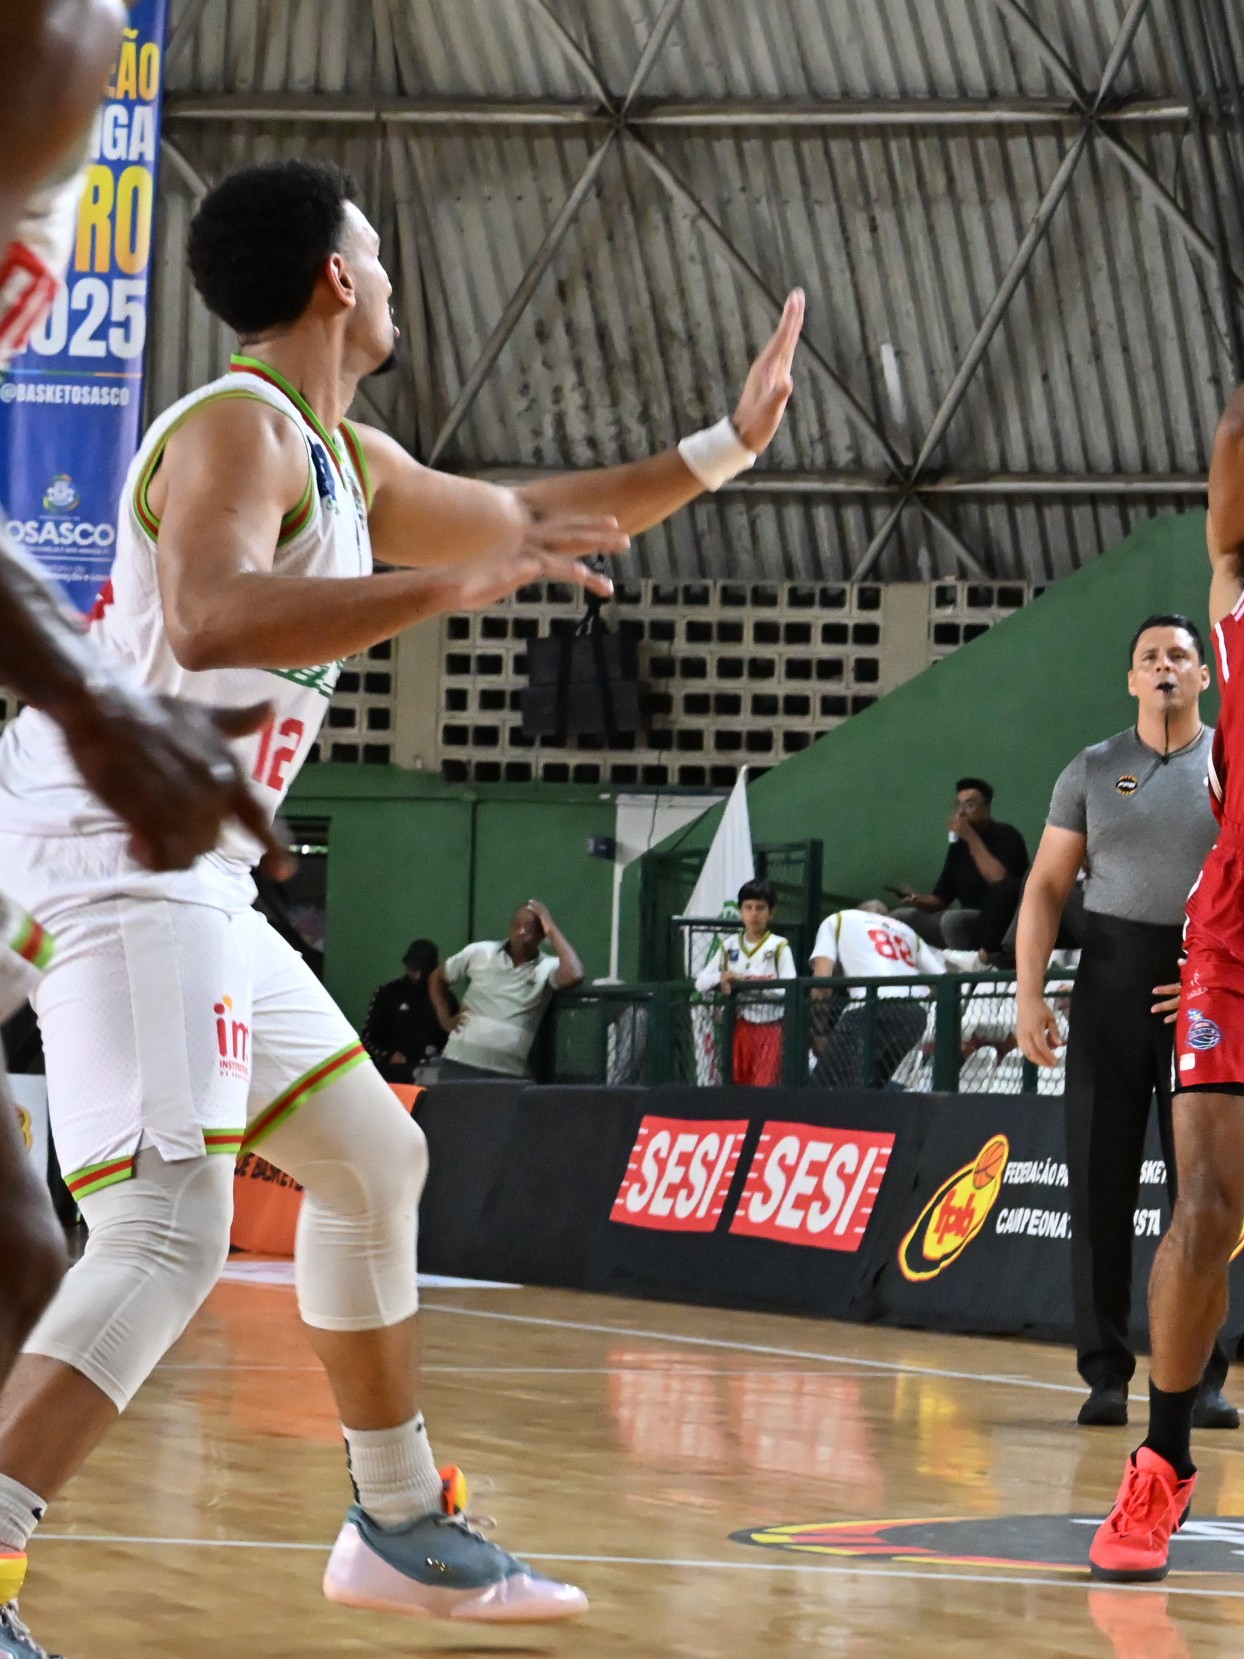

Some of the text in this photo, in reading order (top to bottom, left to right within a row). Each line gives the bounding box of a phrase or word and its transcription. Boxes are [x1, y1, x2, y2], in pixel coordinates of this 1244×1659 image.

[91, 104, 155, 161] IGA
[75, 164, 153, 275] RO
[19, 277, 147, 358] 025
[5, 520, 115, 547] OSASCO
[252, 717, 304, 792] 12
[625, 1130, 736, 1219] SESI
[748, 1135, 879, 1235] SESI
[1055, 1163, 1069, 1187] PA
[996, 1207, 1161, 1240] CAMPEONA ISTA
